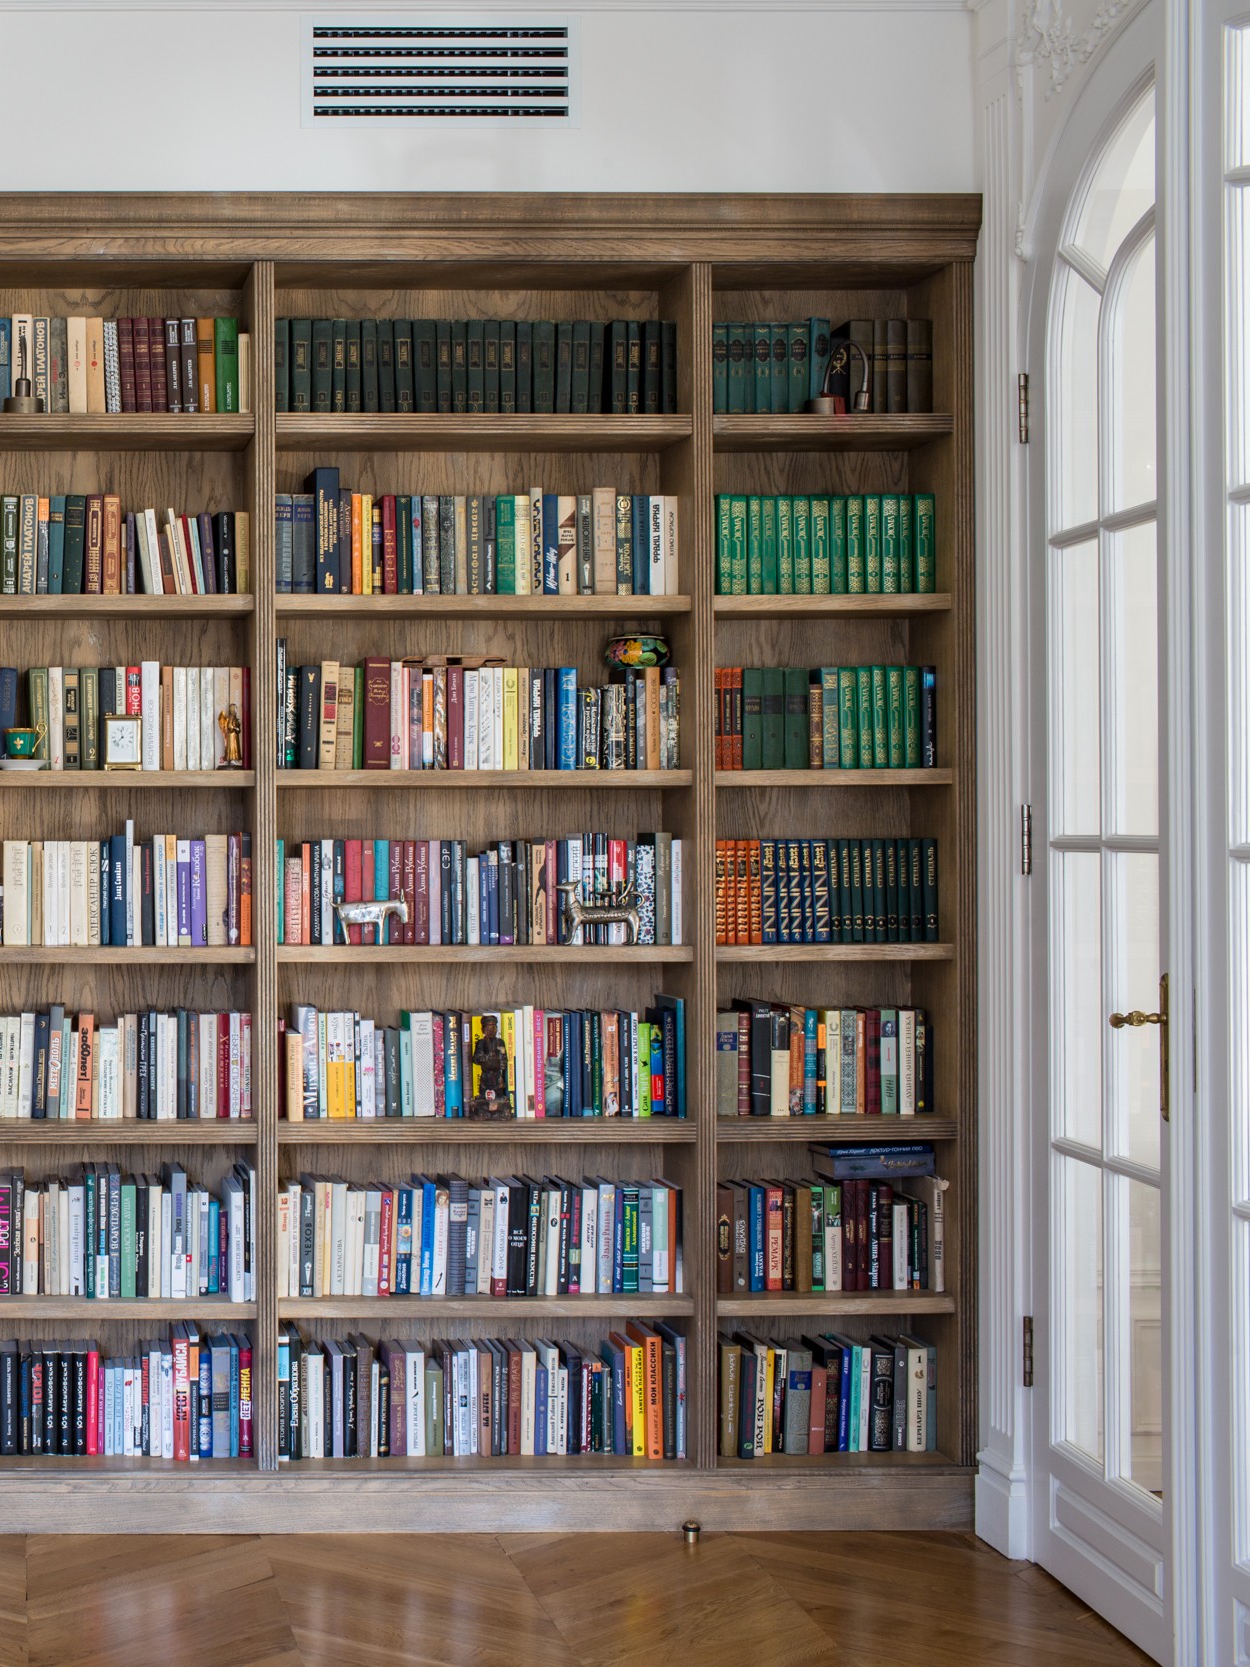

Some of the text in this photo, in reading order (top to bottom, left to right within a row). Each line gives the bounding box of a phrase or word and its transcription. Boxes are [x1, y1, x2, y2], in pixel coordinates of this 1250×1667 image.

[22, 498, 33, 593] АНДРЕЙ ПЛАТОНОВ
[442, 847, 450, 869] СЭР
[89, 848, 99, 939] АЛЕКСАНДР БЛОК
[175, 1389, 187, 1420] КРЕСТ
[290, 1361, 299, 1427] Елена Образцова
